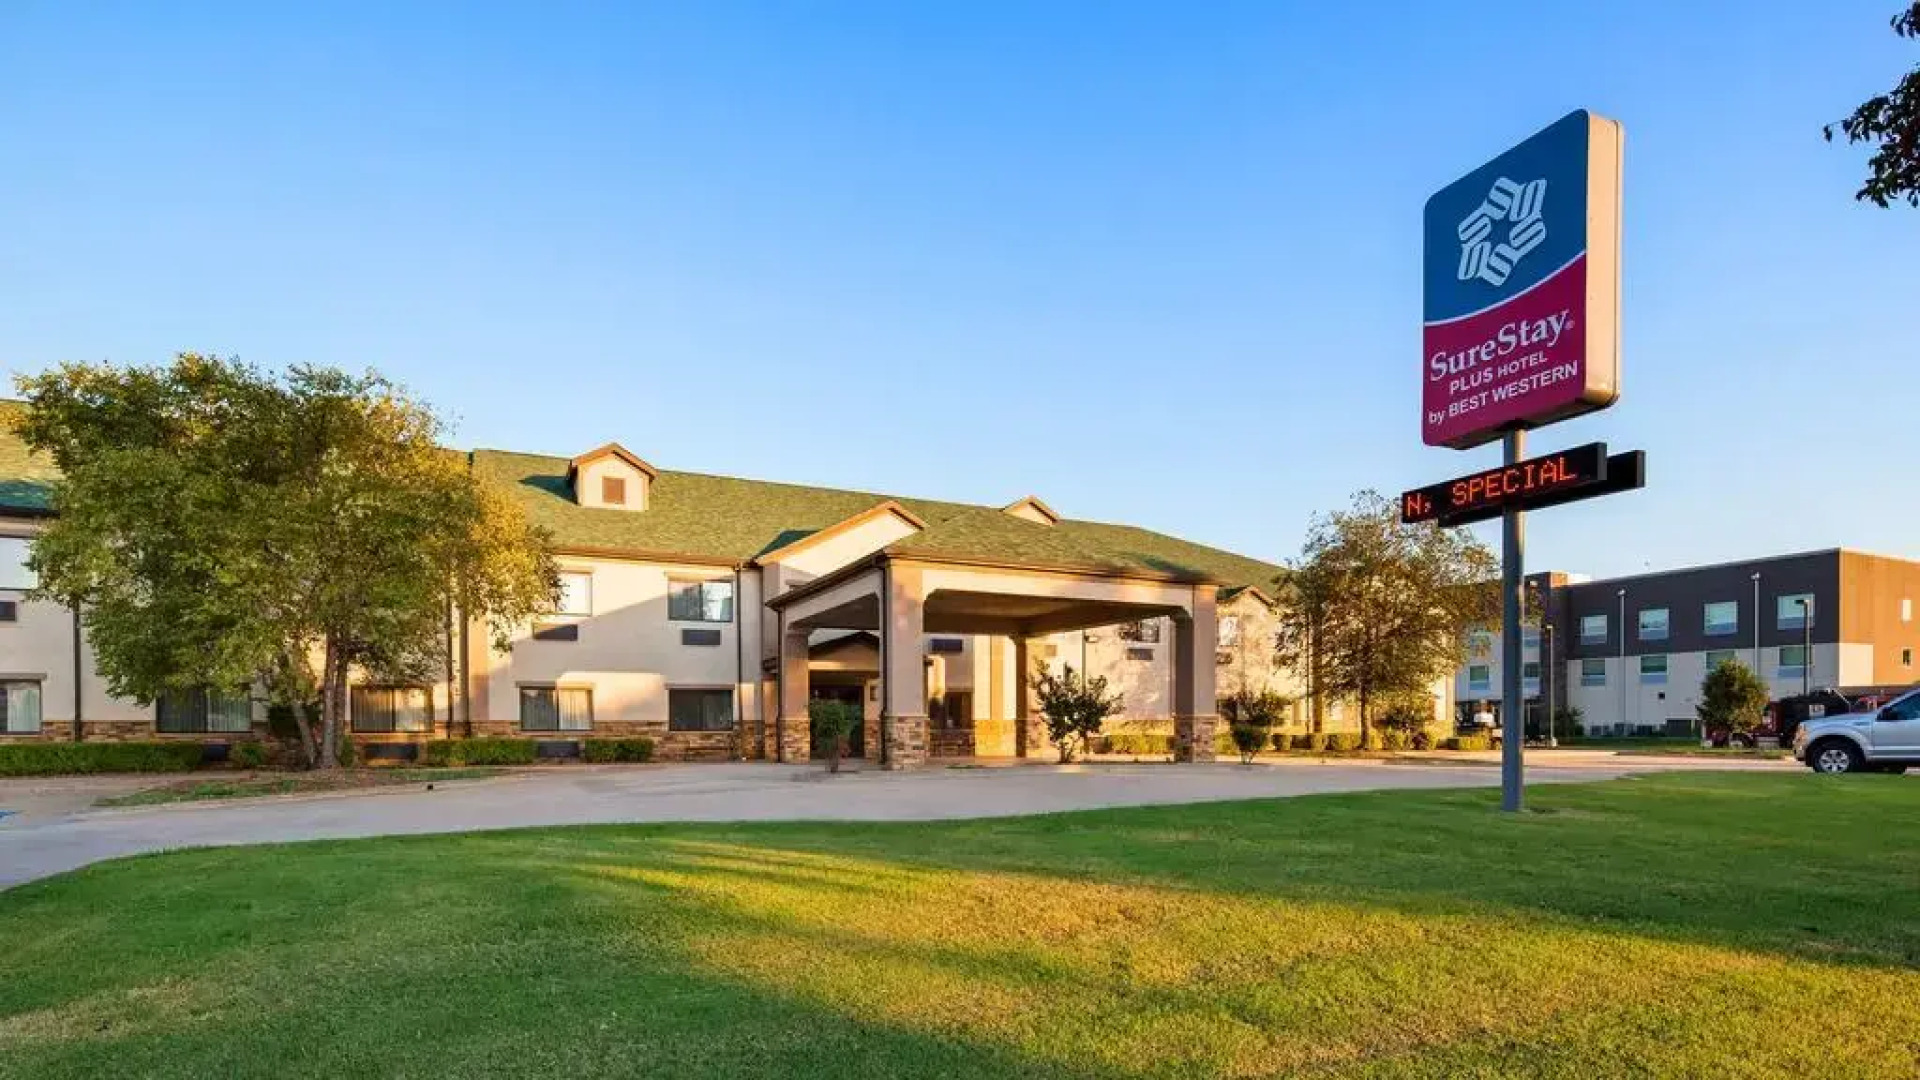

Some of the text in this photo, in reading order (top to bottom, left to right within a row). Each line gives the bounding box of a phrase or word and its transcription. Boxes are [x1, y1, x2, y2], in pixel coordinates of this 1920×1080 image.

[1429, 360, 1578, 425] by BEST WESTERN
[1450, 351, 1548, 394] PLUS HOTEL
[1453, 457, 1576, 505] SPECIAL
